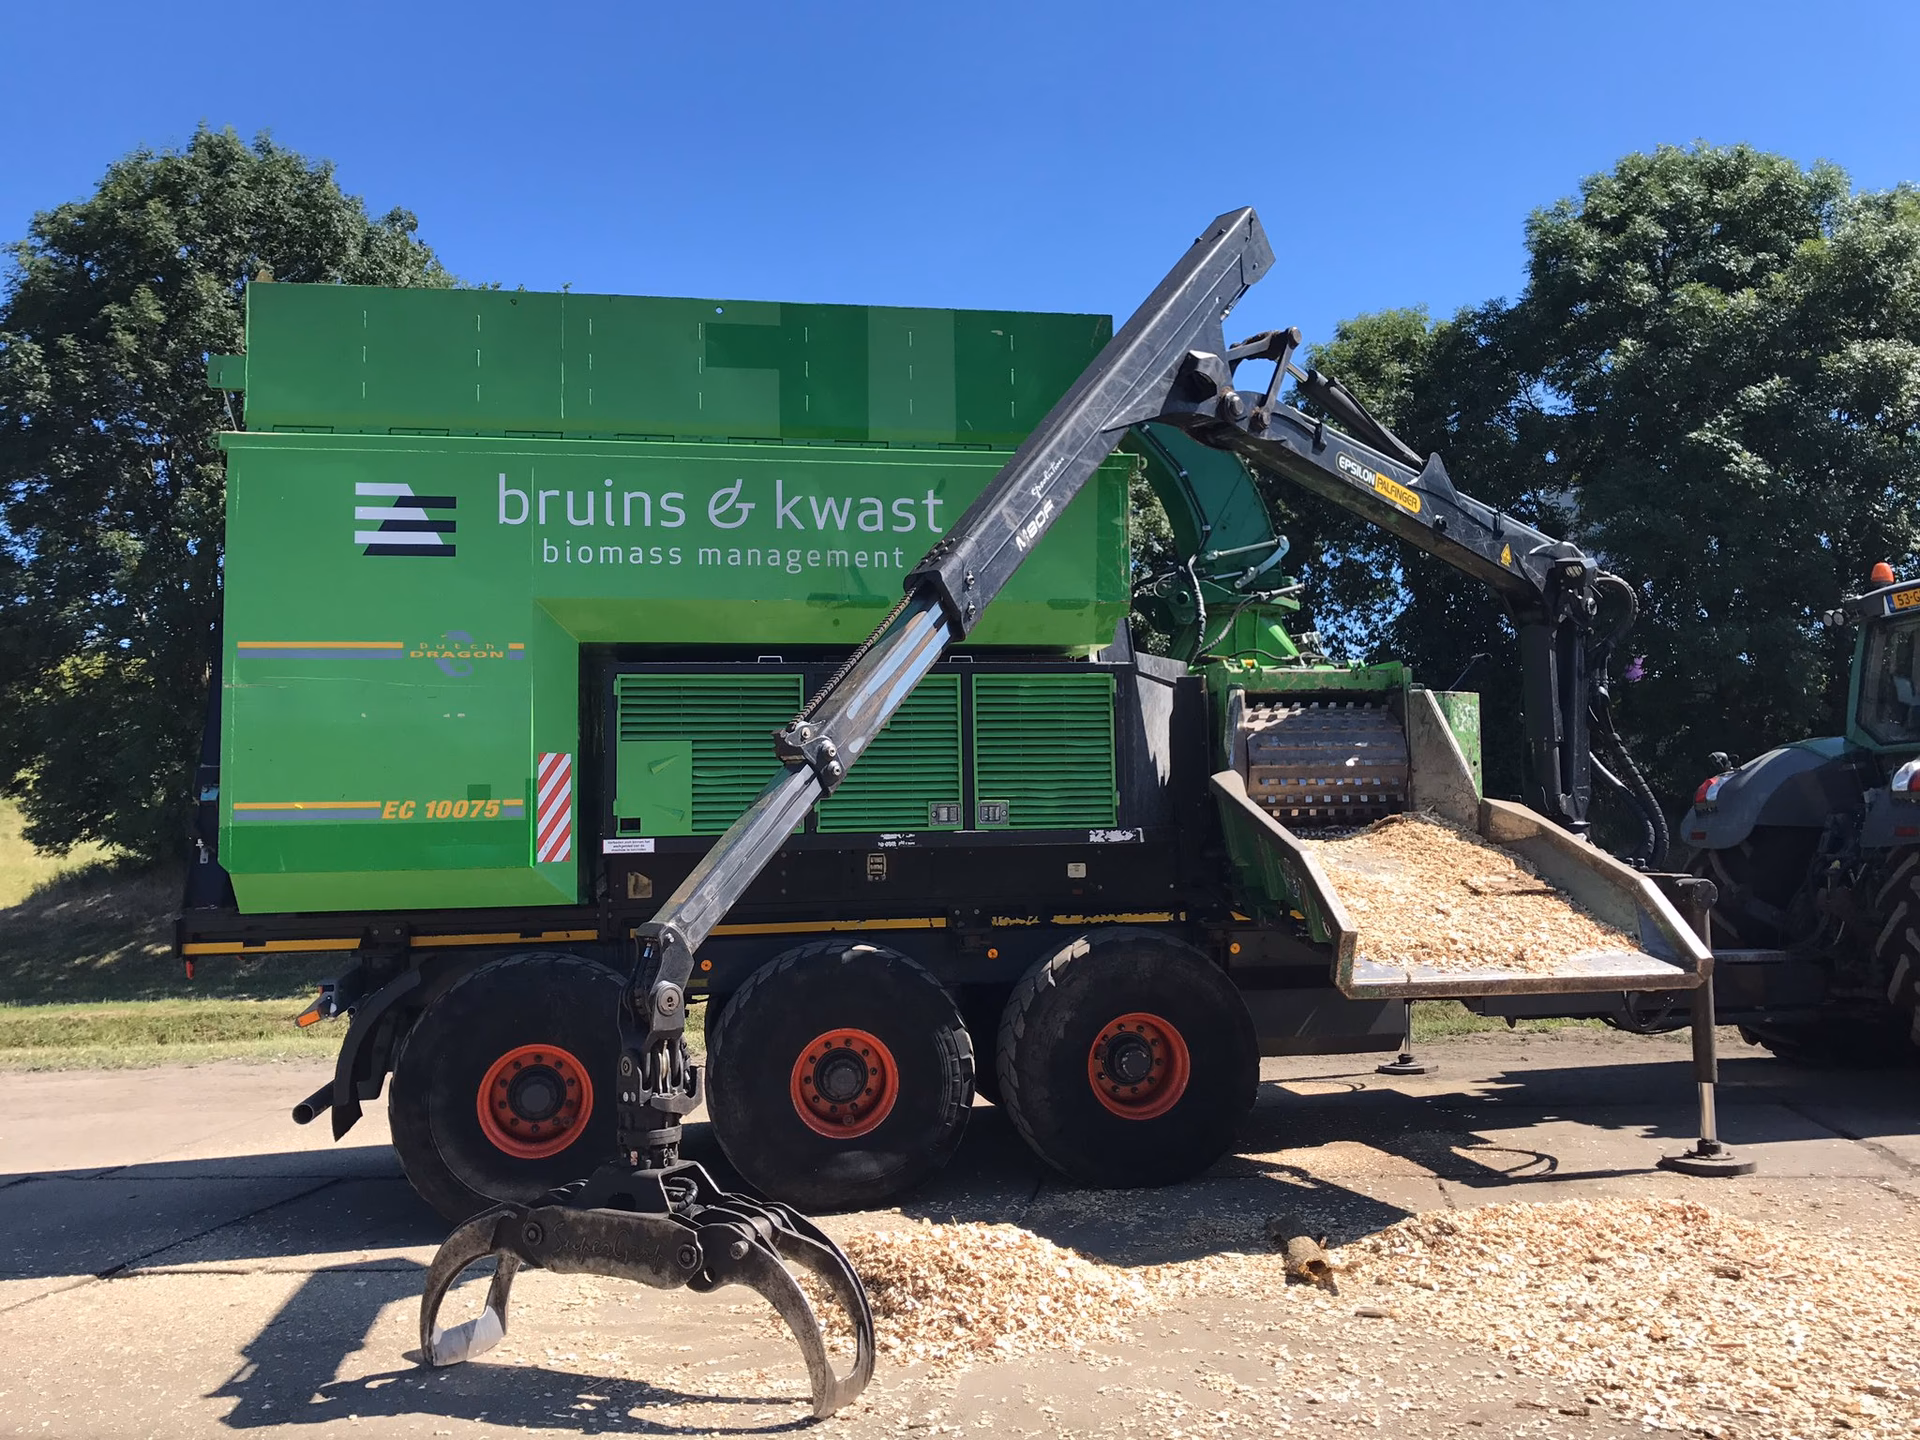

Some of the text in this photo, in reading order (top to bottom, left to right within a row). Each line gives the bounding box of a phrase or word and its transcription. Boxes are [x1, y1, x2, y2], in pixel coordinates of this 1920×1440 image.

[499, 473, 944, 533] bruins & kwast
[1338, 456, 1418, 509] EPSILON PALFINGER
[543, 538, 904, 573] biomass management
[382, 800, 500, 819] EC 10075
